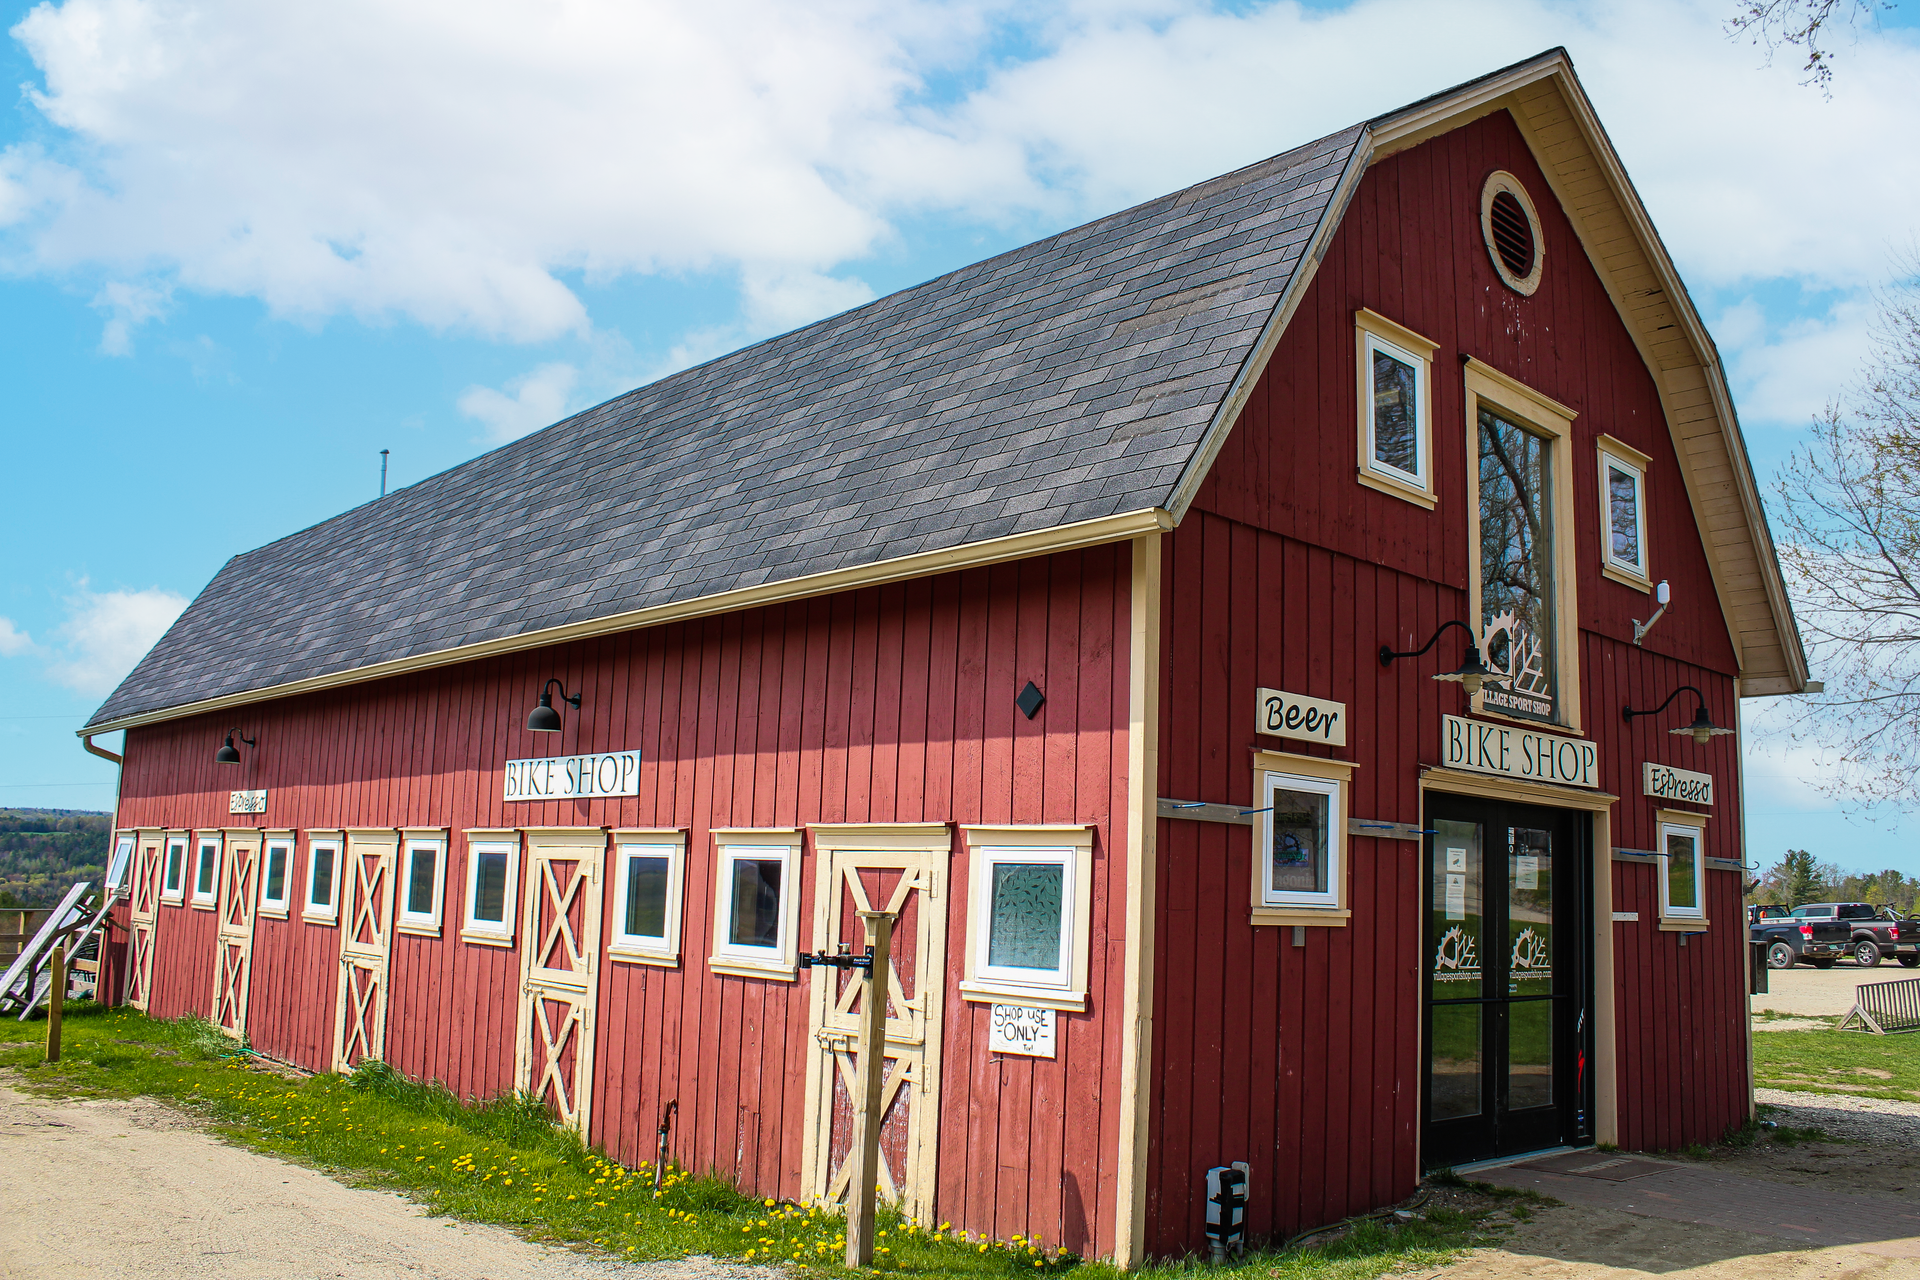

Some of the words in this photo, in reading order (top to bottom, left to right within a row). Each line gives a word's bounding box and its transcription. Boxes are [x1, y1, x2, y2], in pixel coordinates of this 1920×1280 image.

[1265, 696, 1339, 739] Beer
[1509, 695, 1533, 713] SPORT
[1533, 701, 1551, 716] SHOP
[1448, 719, 1511, 772] BIKE
[1522, 734, 1595, 784] SHOP
[506, 760, 556, 796] BIKE
[564, 755, 634, 794] SHOP
[1651, 767, 1710, 802] Espresso
[994, 1004, 1024, 1027] SHOP
